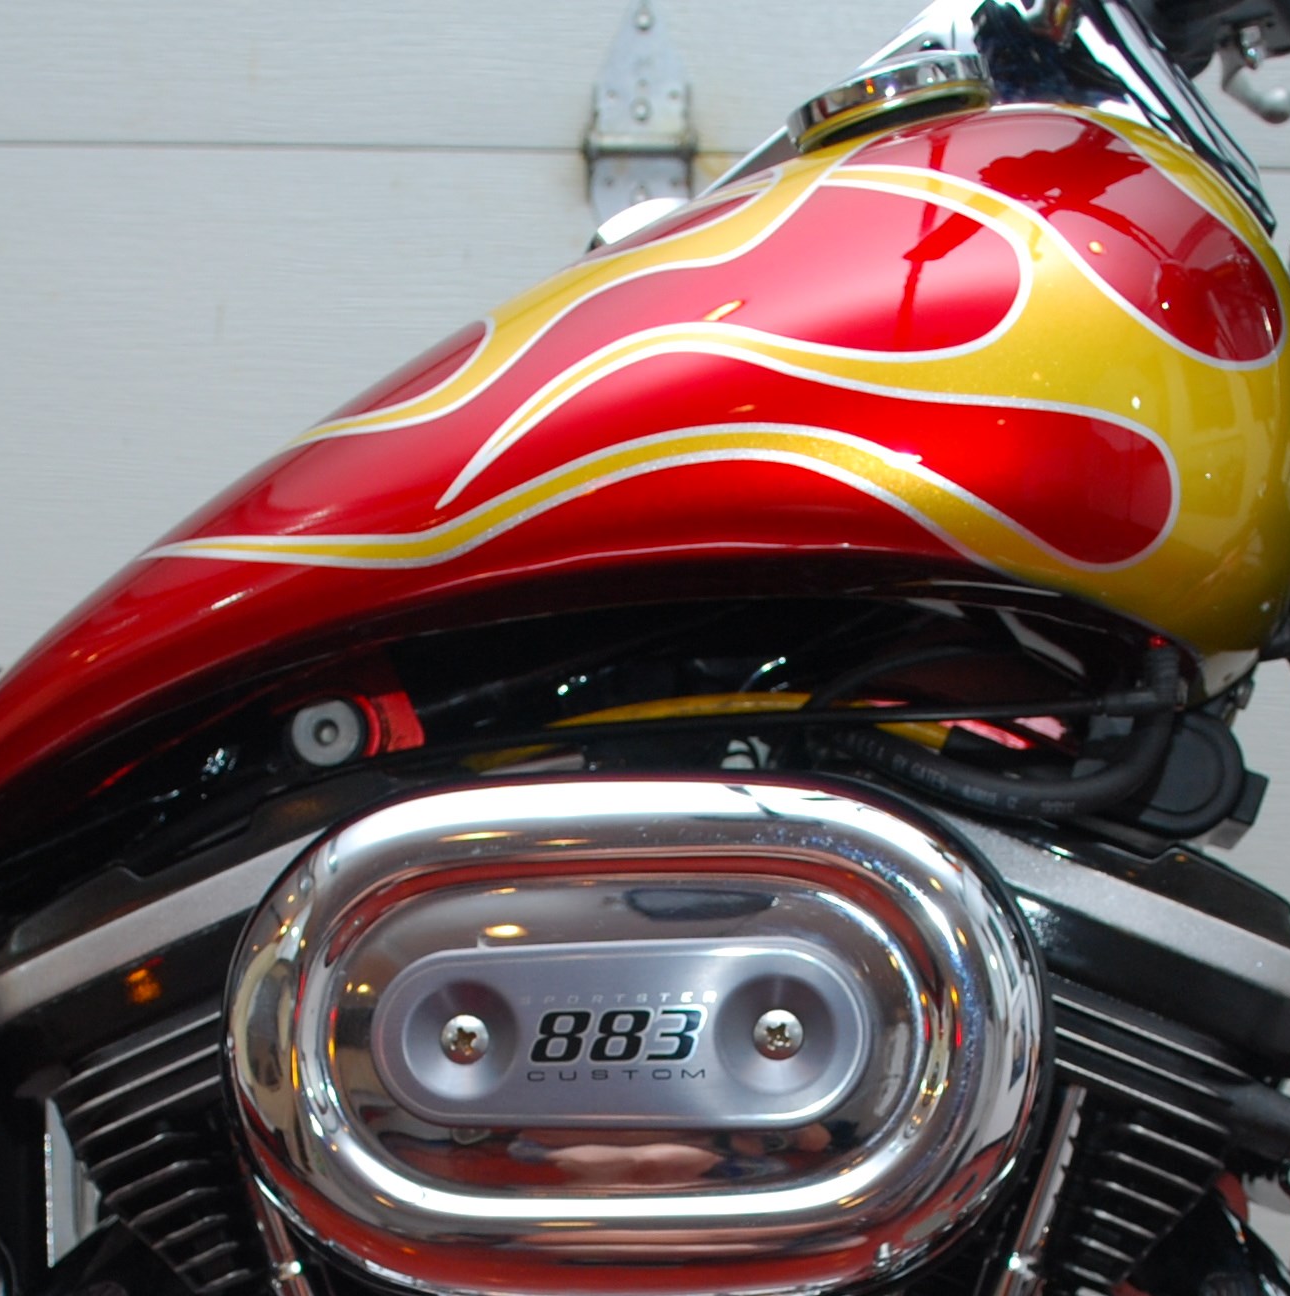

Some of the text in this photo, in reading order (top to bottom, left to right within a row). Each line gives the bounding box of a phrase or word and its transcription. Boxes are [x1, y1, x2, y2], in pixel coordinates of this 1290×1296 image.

[520, 990, 717, 1005] SPORTSTER
[529, 1008, 704, 1064] 883
[527, 1068, 706, 1082] CUSTOM
